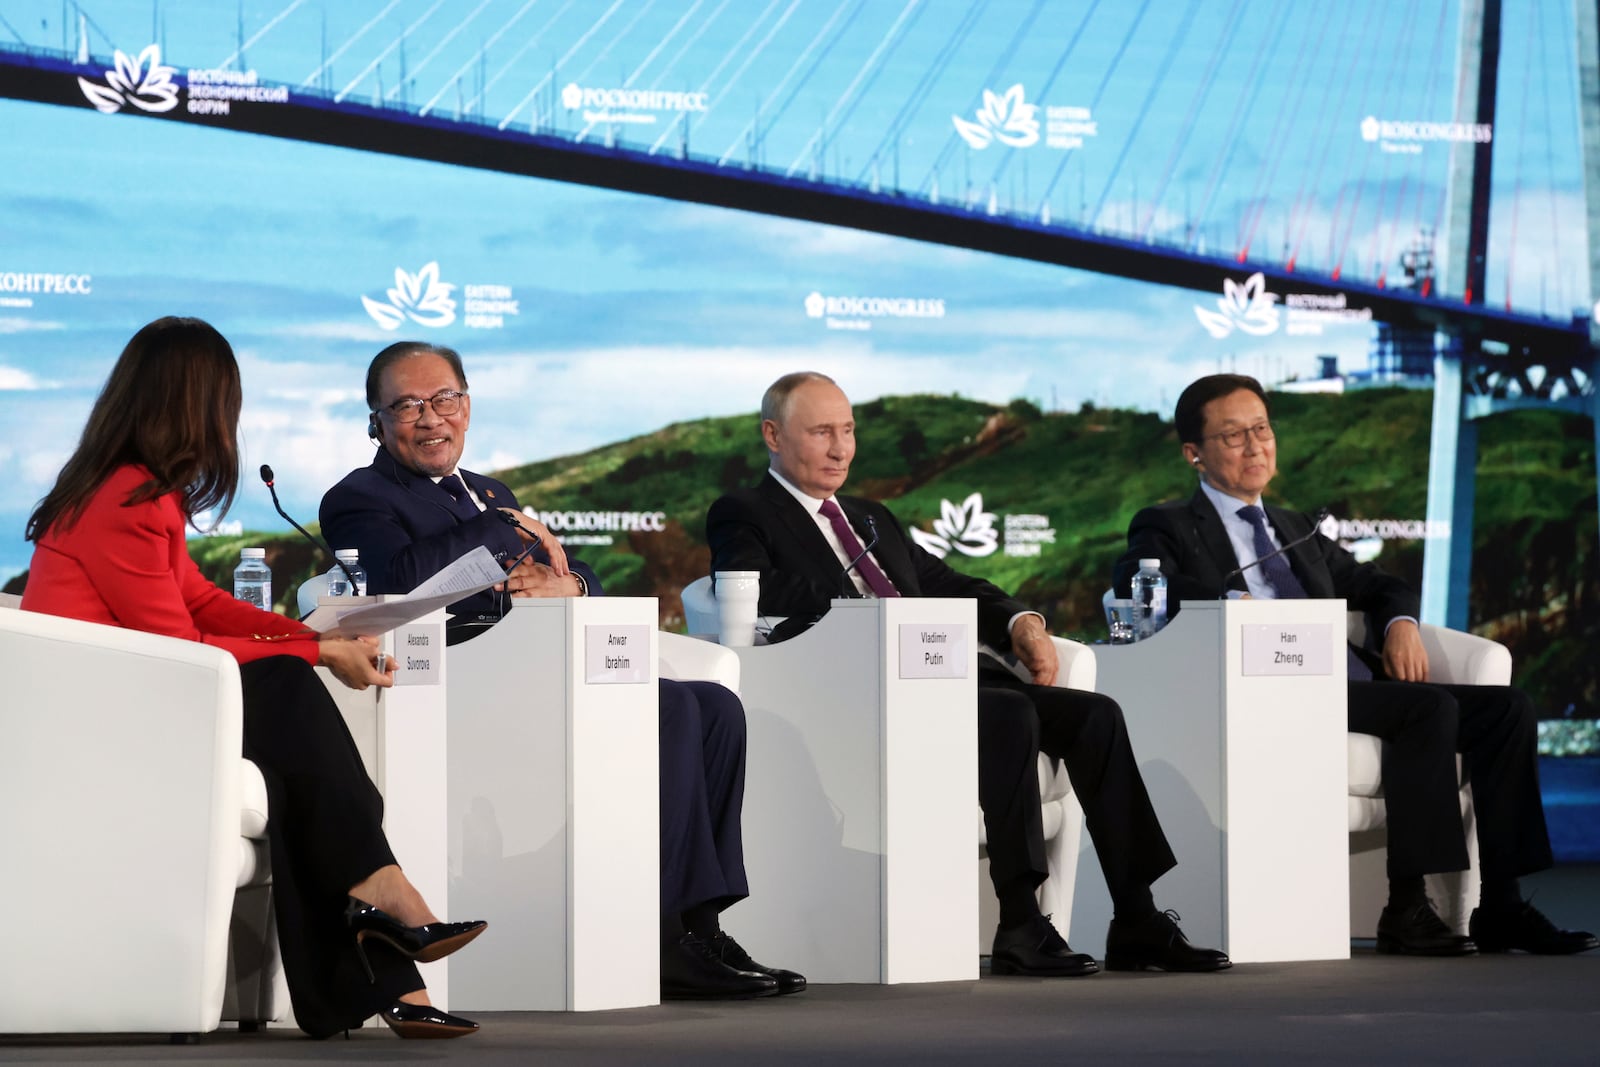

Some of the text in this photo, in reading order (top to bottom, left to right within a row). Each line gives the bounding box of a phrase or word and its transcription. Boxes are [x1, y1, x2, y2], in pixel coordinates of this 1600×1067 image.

[187, 84, 288, 103] ЭКОНОМИЧЕСКИЙ
[583, 87, 708, 112] РОСКОНГРЕСС
[187, 100, 230, 115] ФОРУМ
[1380, 120, 1492, 143] ROSCONGRESS
[464, 299, 520, 316] ECONOMIC
[826, 296, 945, 318] ROSCONGRESS
[540, 511, 666, 532] РОСКОНГРЕСС
[407, 632, 429, 646] Alexandra
[608, 633, 627, 646] Anwar
[920, 631, 947, 644] Vladimir
[1280, 632, 1297, 643] Han
[407, 655, 430, 671] Suvorova
[605, 655, 630, 669] Ibrahim
[924, 651, 944, 665] Putin
[1274, 650, 1304, 667] Zheng
